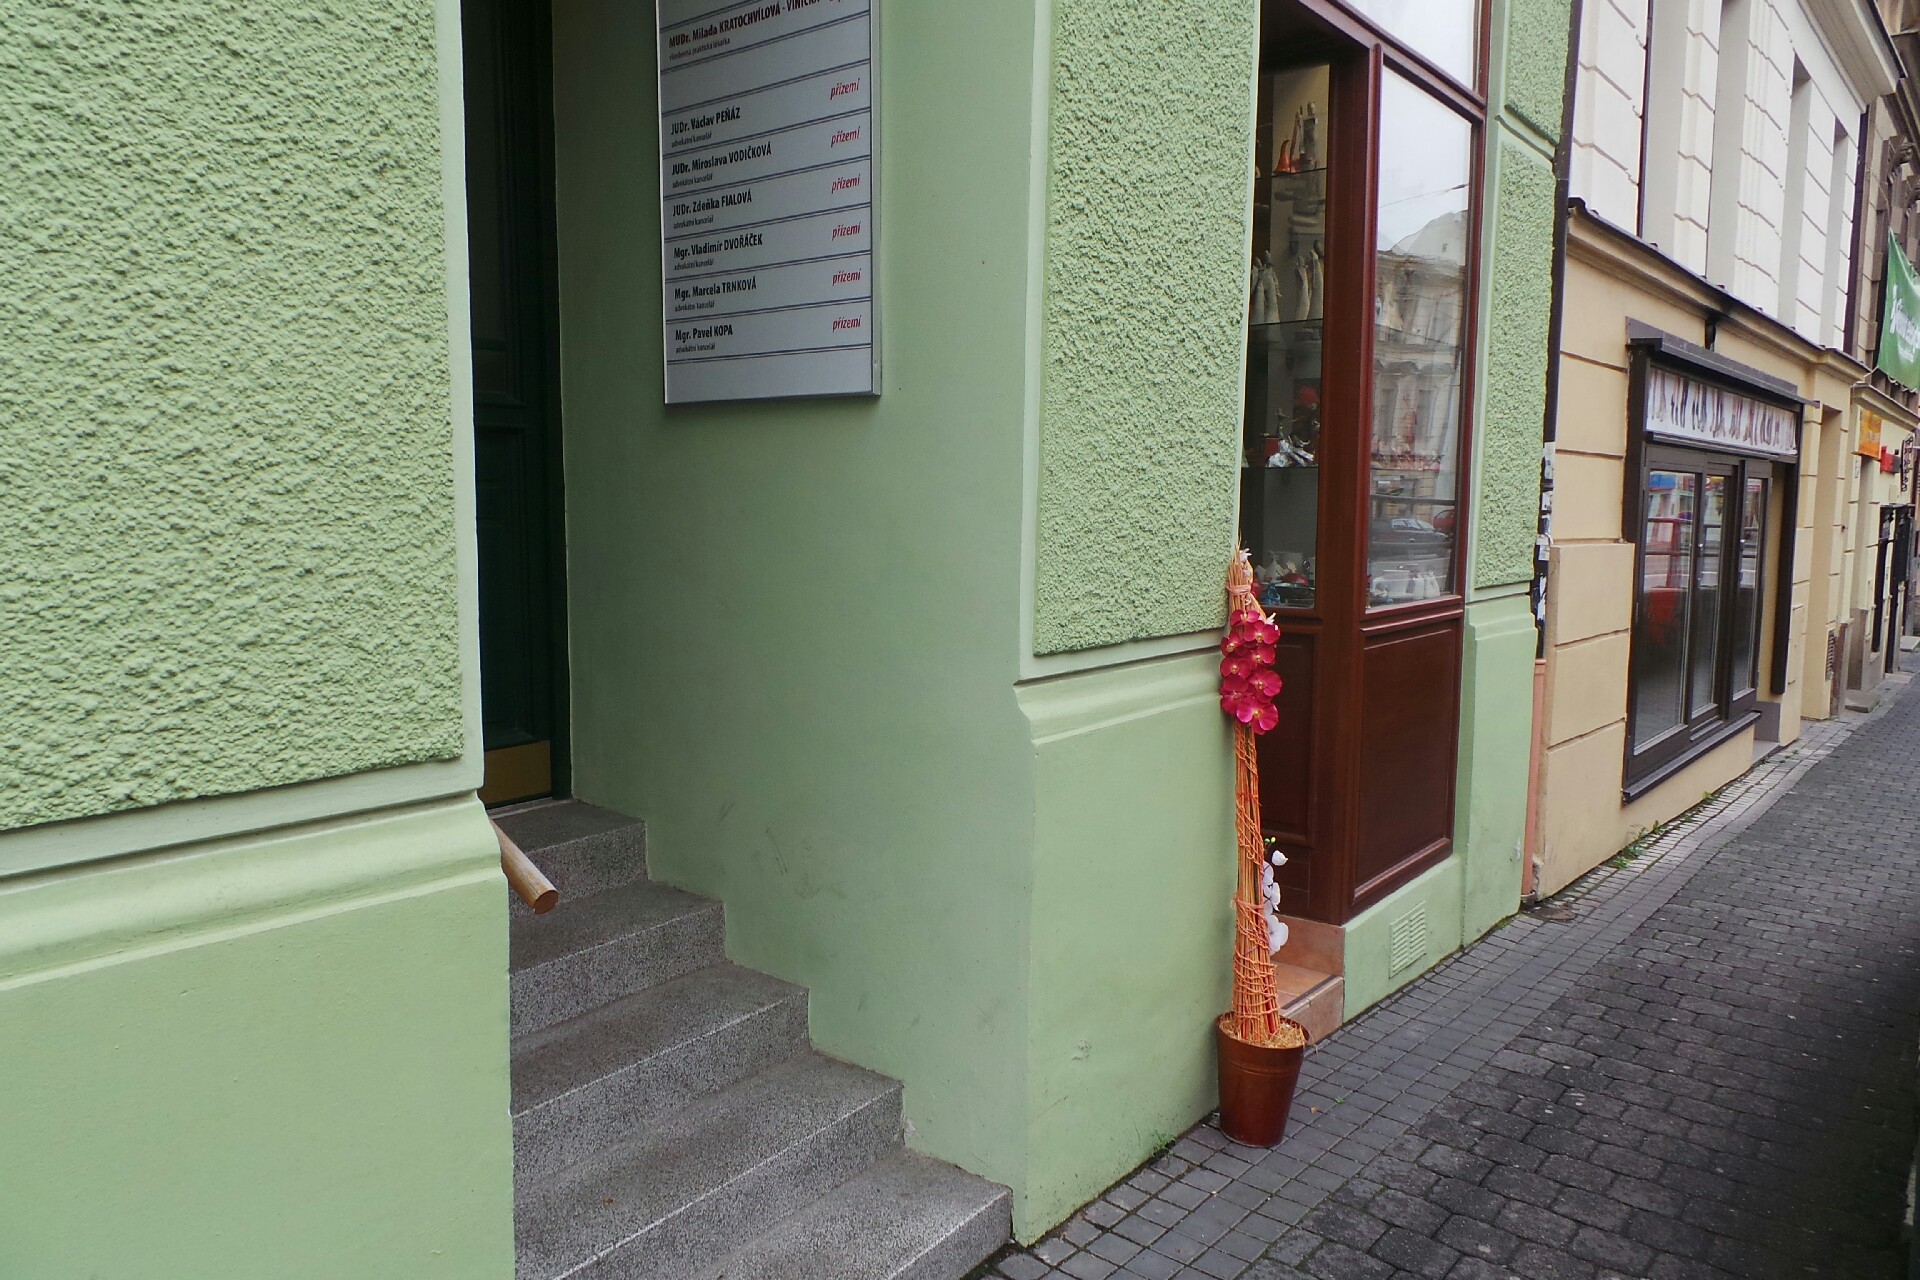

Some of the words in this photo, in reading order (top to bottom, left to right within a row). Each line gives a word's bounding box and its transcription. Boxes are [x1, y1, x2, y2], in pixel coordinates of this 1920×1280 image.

[669, 33, 690, 48] MUDr.
[692, 25, 717, 41] Milada
[719, 0, 781, 33] KRATOCHVÍLOVÁ
[830, 78, 860, 100] přízemí
[671, 123, 690, 135] JUDr.
[691, 115, 714, 129] Václav
[831, 126, 860, 148] přízemí
[672, 163, 690, 175] JUDr.
[692, 155, 727, 171] Miroslava
[729, 141, 772, 163] VODIČKOVÁ
[832, 174, 860, 194] přízemí
[673, 204, 691, 216] JUDr.
[693, 198, 720, 213] Zdeňka
[721, 188, 752, 207] FIALOVÁ
[832, 221, 861, 240] přízemí
[674, 247, 690, 260] Mgr.
[691, 240, 722, 256] Vladimír
[724, 233, 763, 251] DVOŘÁČEK
[675, 288, 690, 301] Mgr.
[692, 284, 720, 297] Marcela
[722, 275, 757, 293] TRNKOVÁ
[832, 268, 861, 286] přízemí
[675, 330, 691, 343] Mgr.
[693, 326, 712, 339] Pavel
[714, 324, 733, 337] KOPA
[832, 315, 861, 333] přízemí
